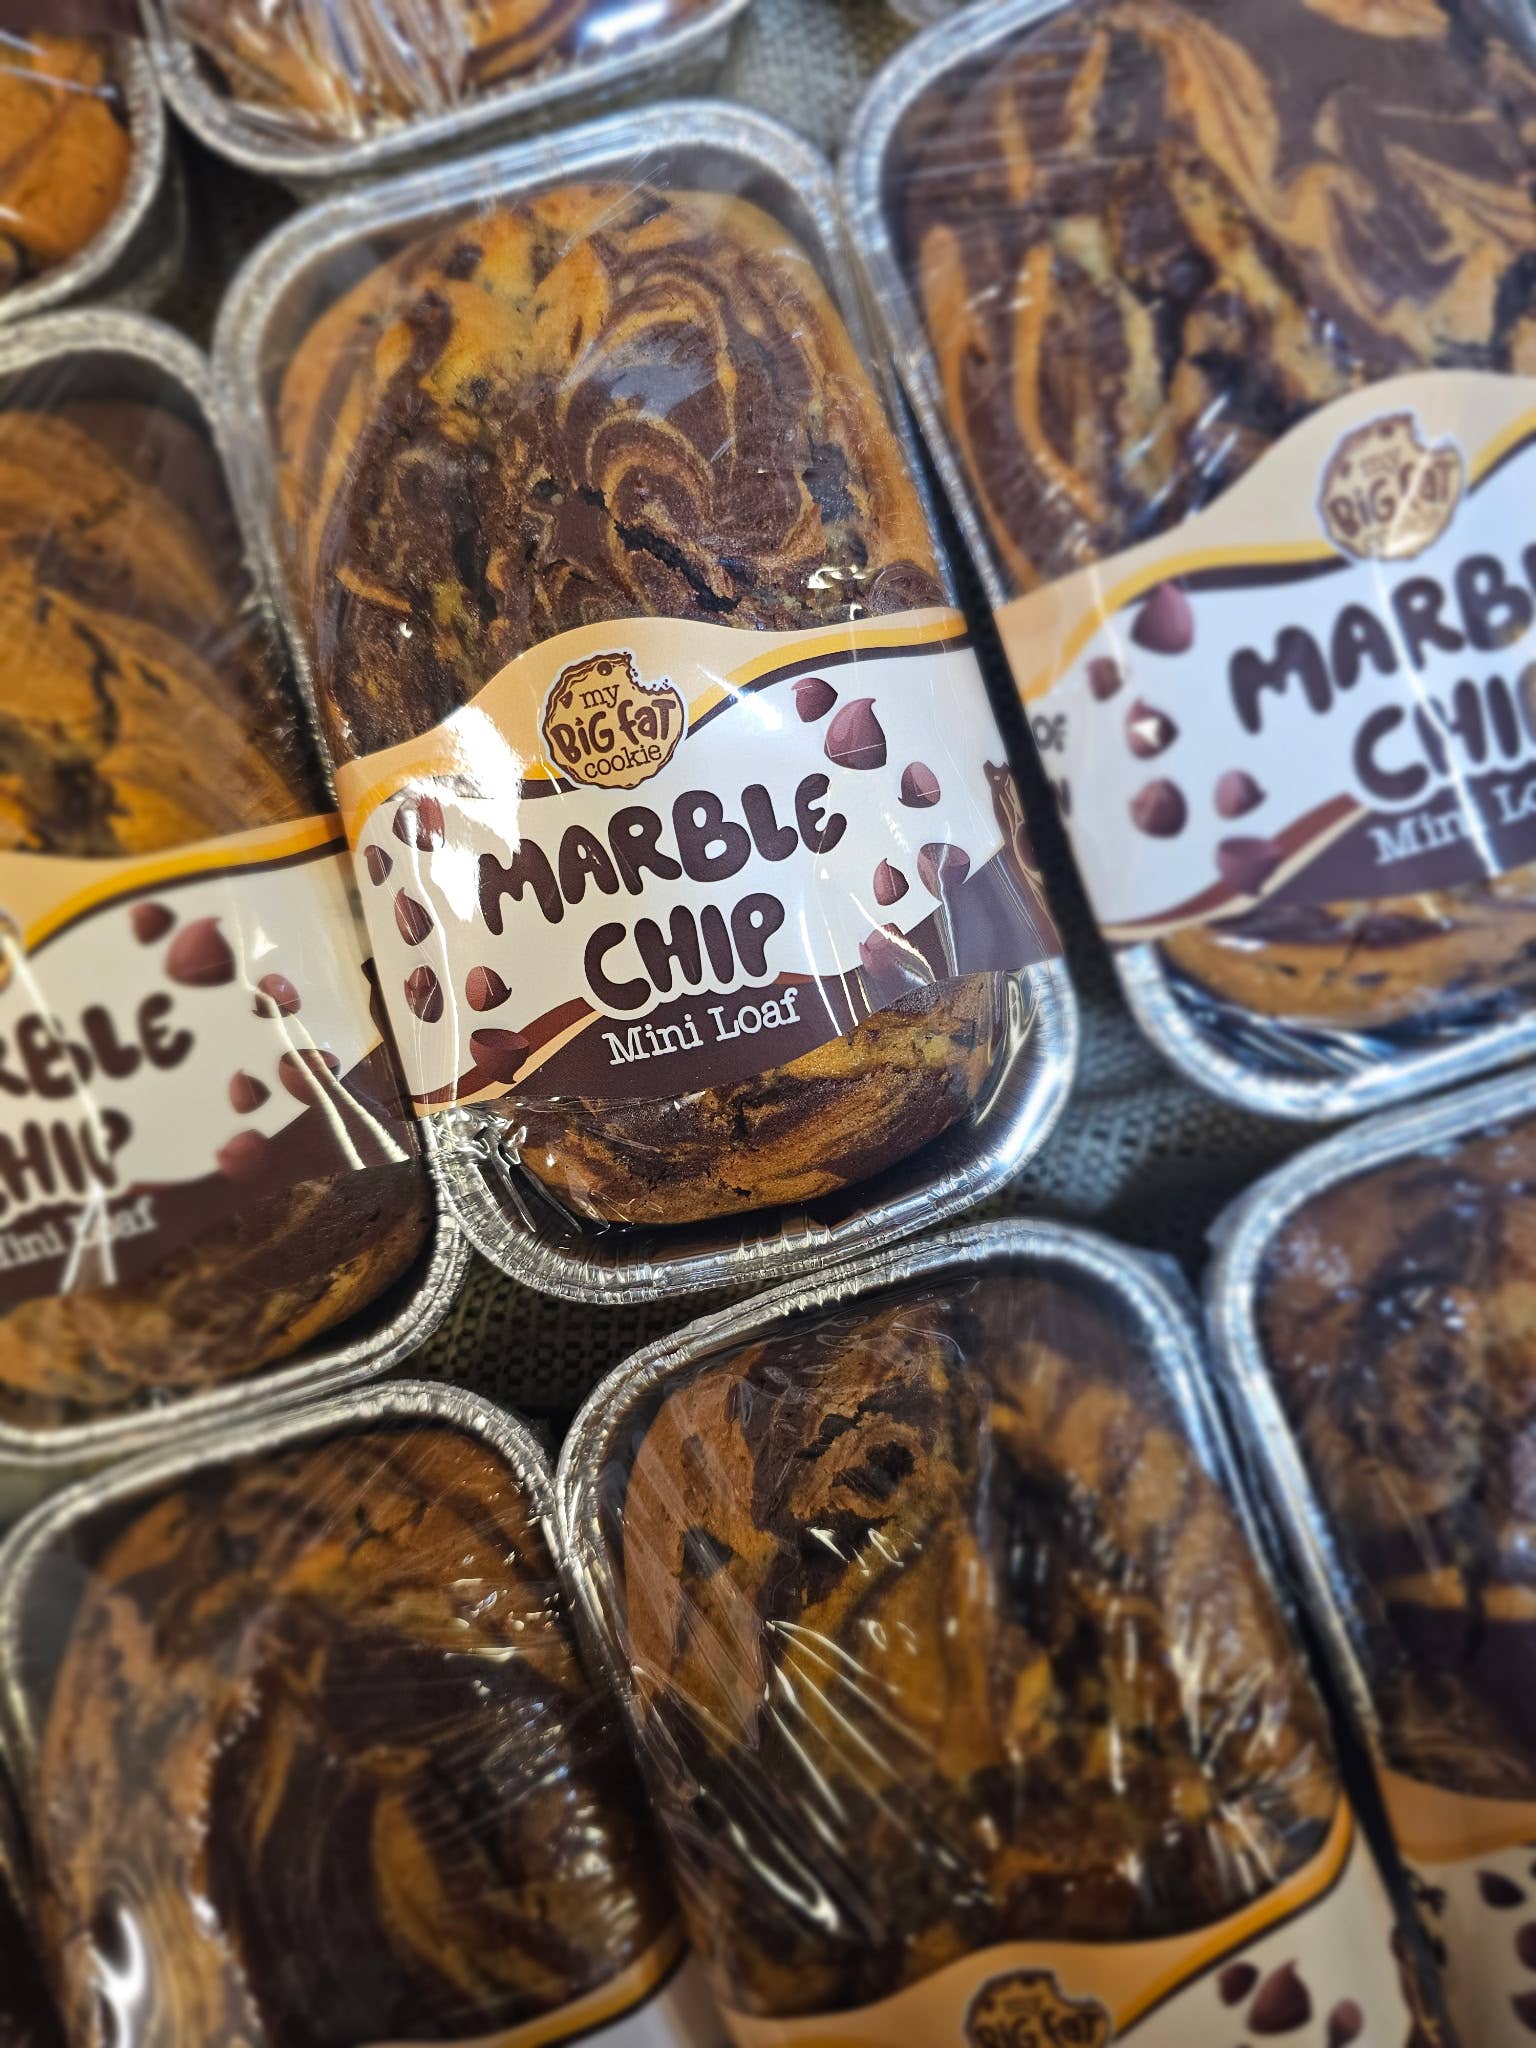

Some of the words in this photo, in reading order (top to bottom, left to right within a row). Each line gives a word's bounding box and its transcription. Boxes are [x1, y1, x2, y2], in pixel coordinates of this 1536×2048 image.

[1228, 541, 1536, 735] MARB
[579, 684, 620, 709] my
[584, 744, 662, 778] cookie
[478, 773, 847, 936] MARBLE
[1367, 808, 1478, 866] Min
[584, 893, 785, 1011] CHIP
[602, 1014, 703, 1066] Mini
[707, 987, 800, 1042] Loaf
[0, 1108, 134, 1216] HIP
[0, 1221, 66, 1270] ini
